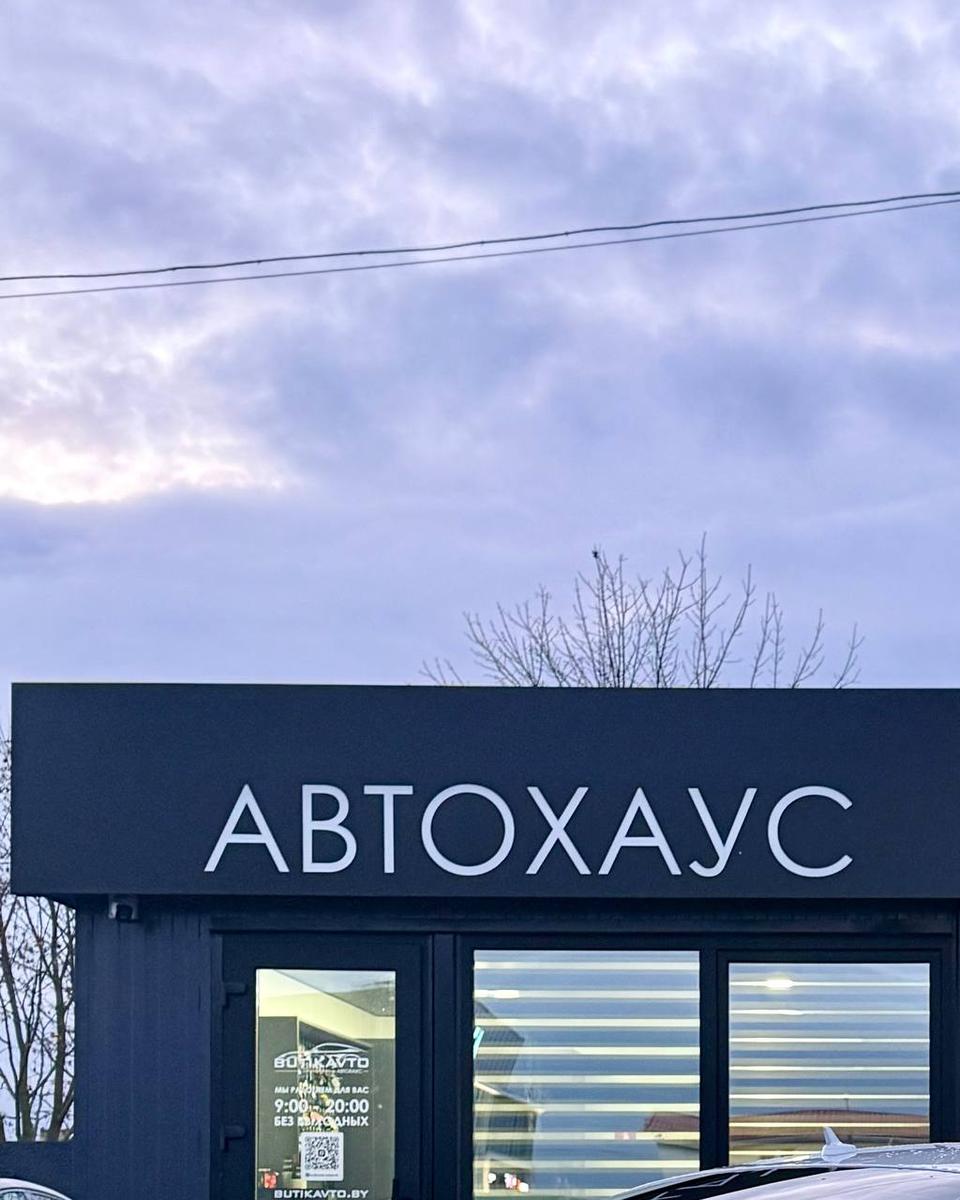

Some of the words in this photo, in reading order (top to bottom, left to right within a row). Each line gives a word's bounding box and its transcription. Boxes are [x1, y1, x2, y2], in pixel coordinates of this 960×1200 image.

[204, 784, 853, 878] АВТОХАУС
[274, 1056, 369, 1068] BUTIKAVTO
[352, 1086, 369, 1094] ВАС
[274, 1098, 308, 1113] 9:00
[326, 1098, 369, 1113] 20:00
[274, 1116, 294, 1126] БЕЗ
[274, 1189, 369, 1198] BUTIKAVTO.BY
